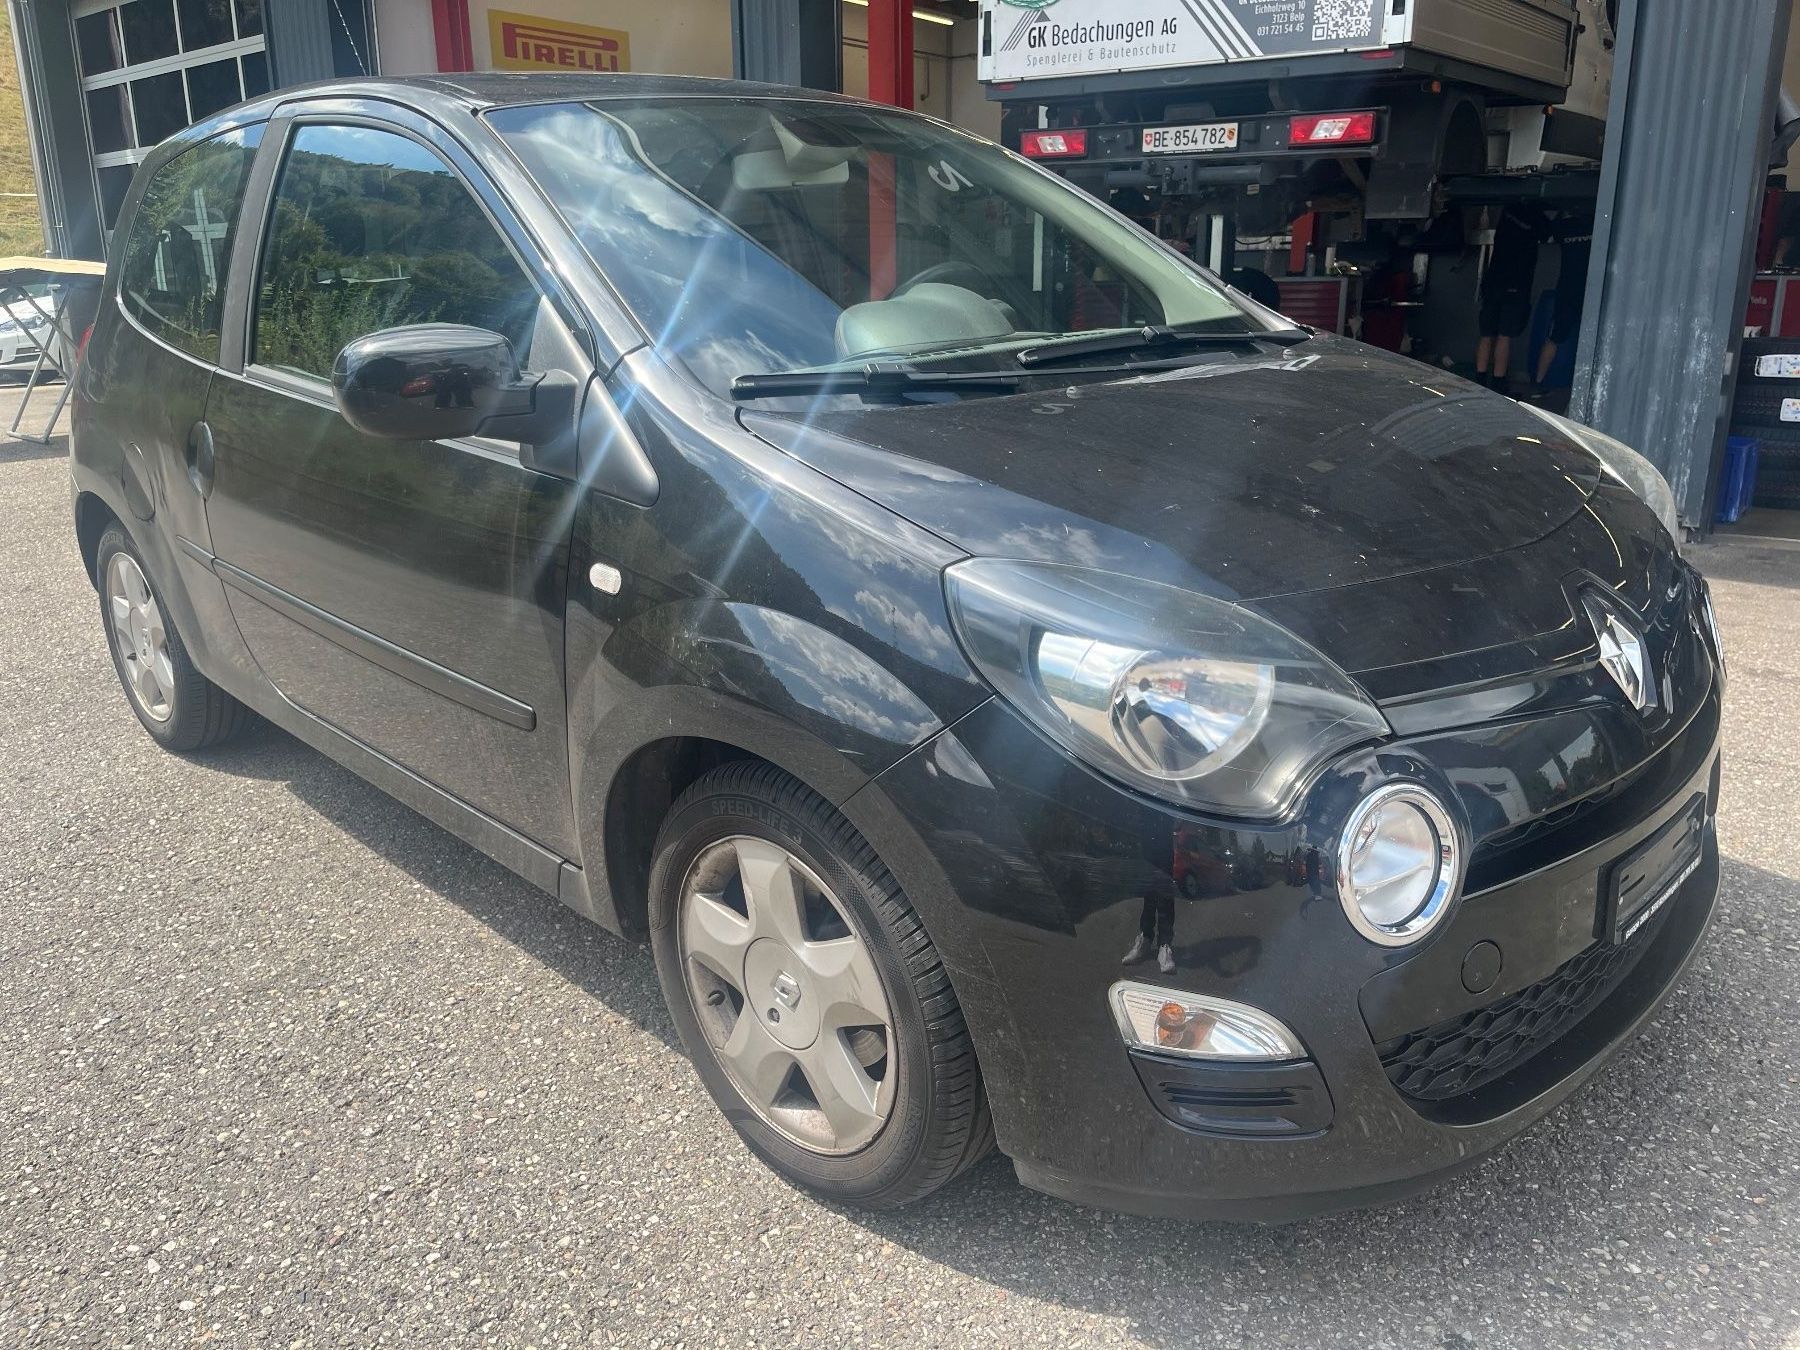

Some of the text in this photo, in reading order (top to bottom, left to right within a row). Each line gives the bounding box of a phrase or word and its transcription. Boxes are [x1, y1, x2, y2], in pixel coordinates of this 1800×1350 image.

[1255, 2, 1296, 15] Eichholzweg
[1272, 12, 1305, 23] 3123 Belp
[1028, 17, 1177, 49] GK Bedachungen AG
[1256, 22, 1304, 36] 031 721 54 45
[502, 22, 619, 72] PIRELLI
[1026, 43, 1177, 67] Spenglerei & Bautenschutz
